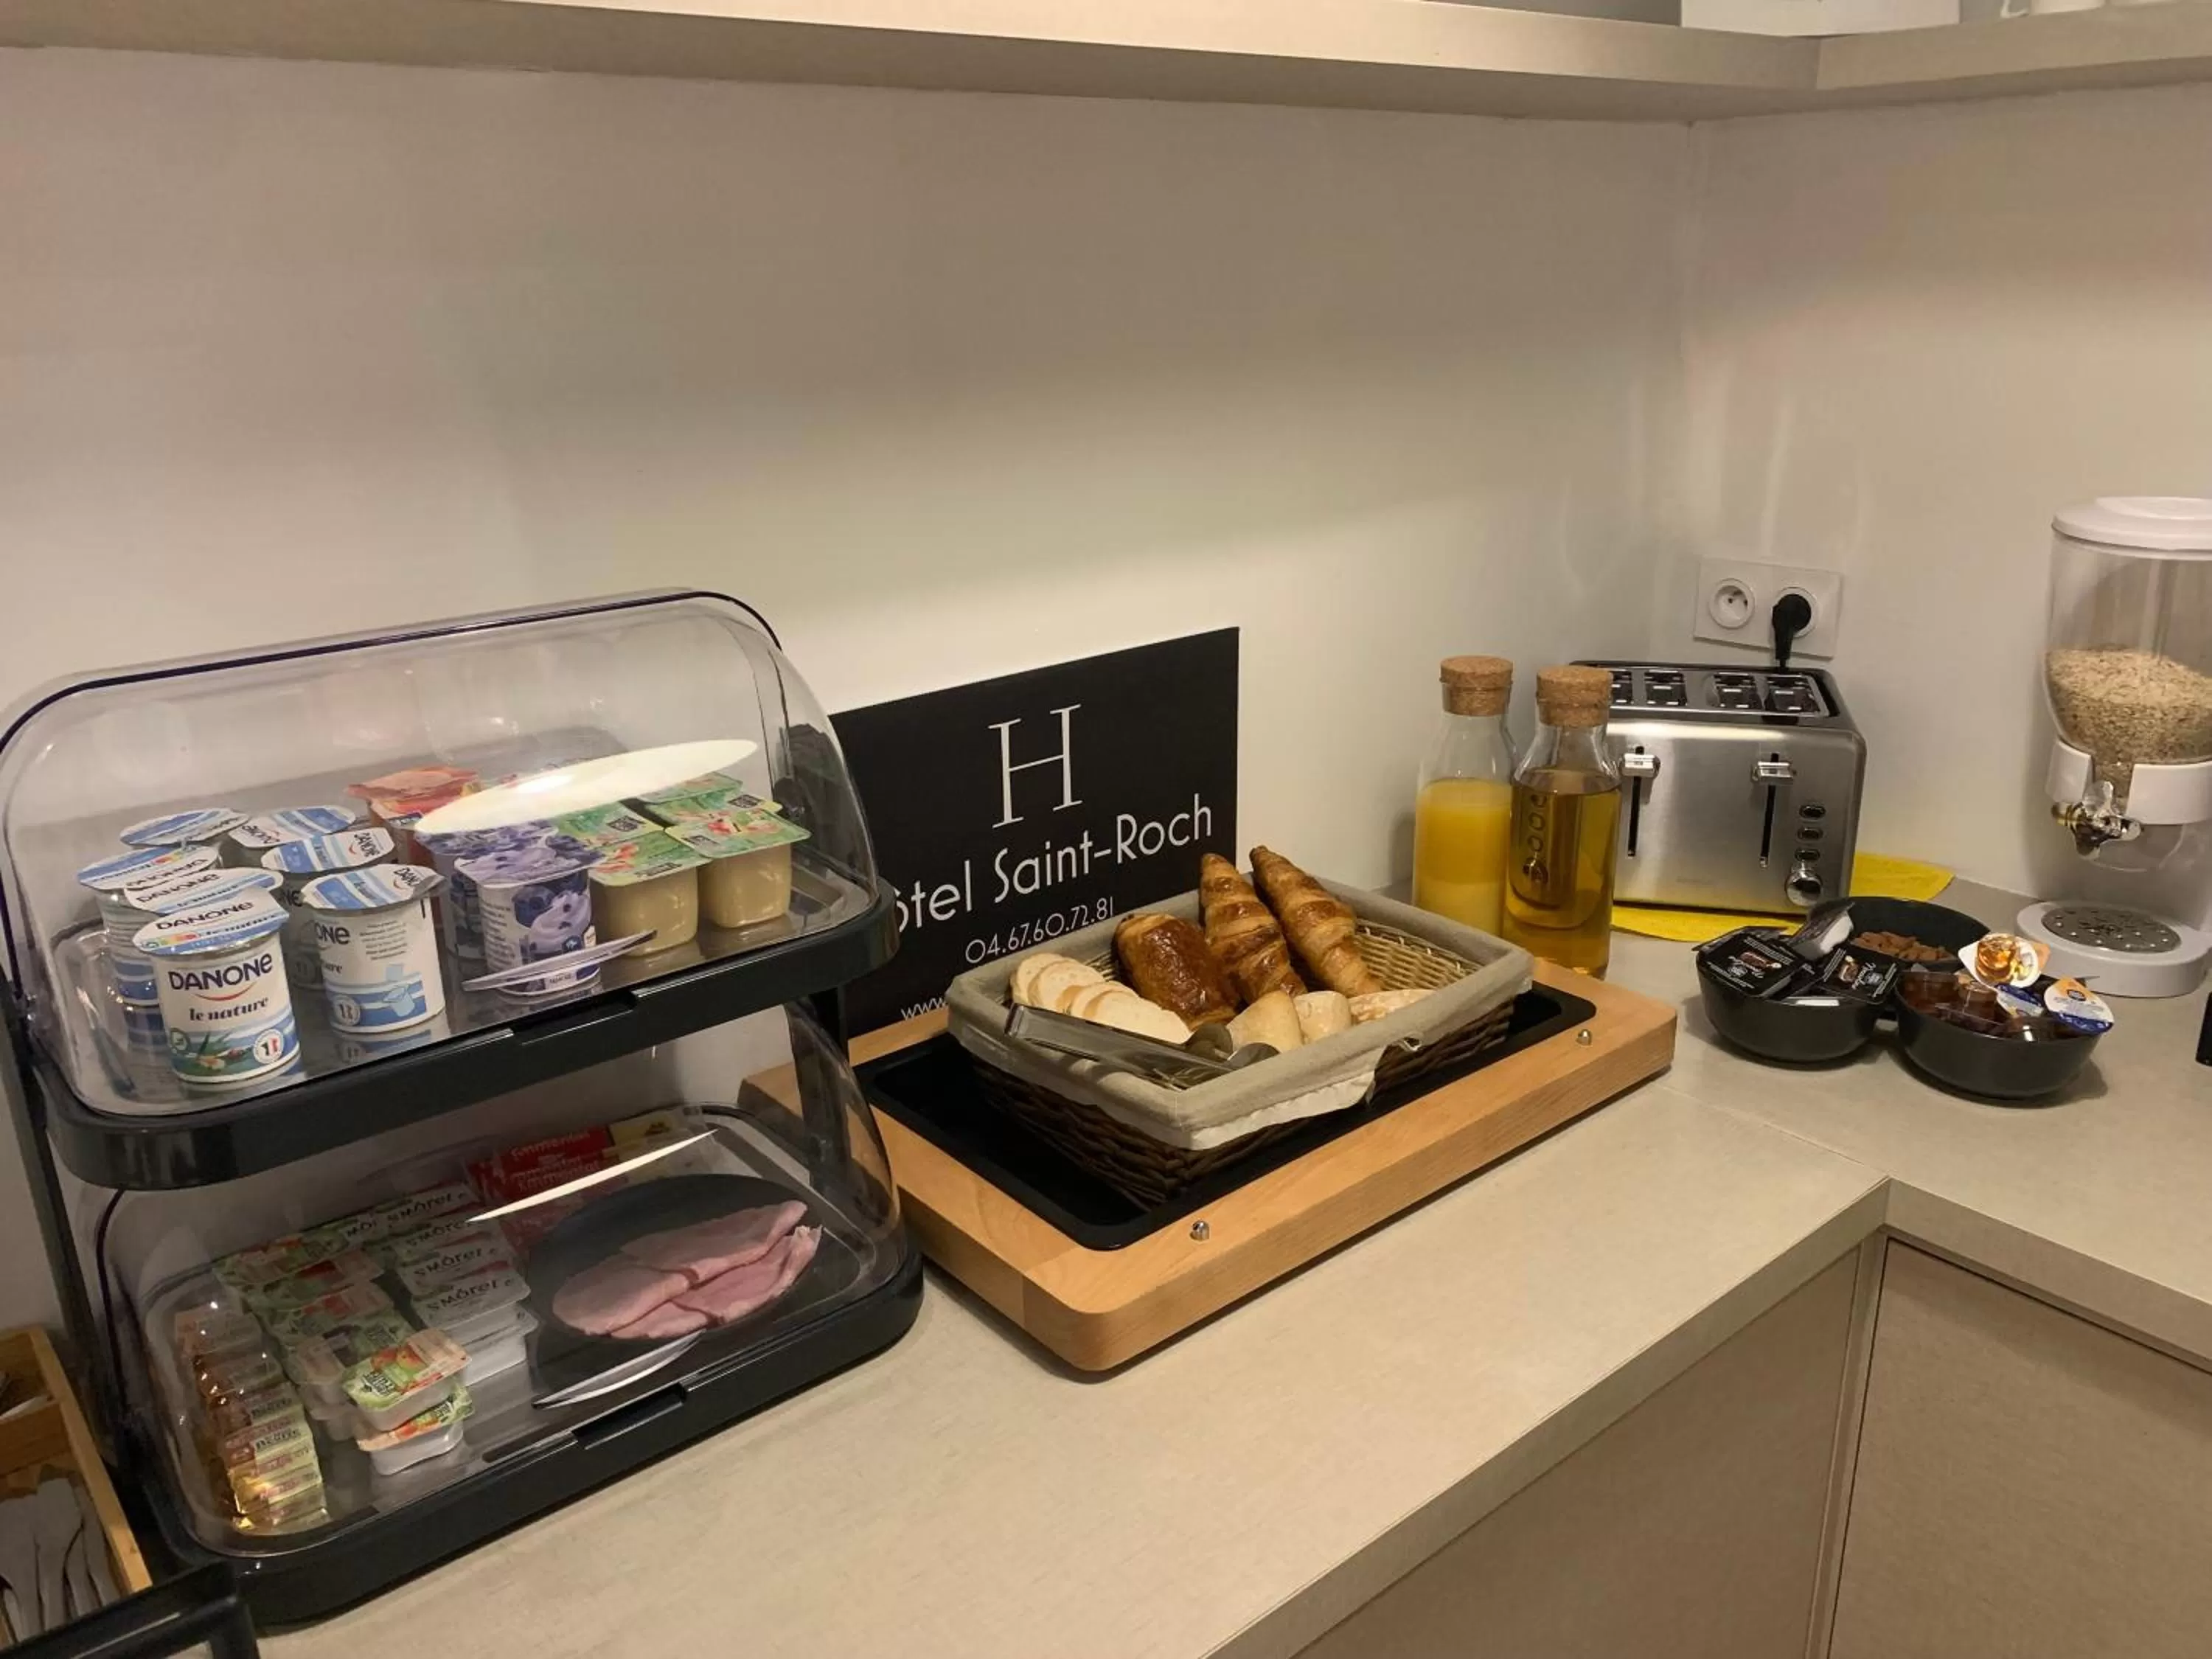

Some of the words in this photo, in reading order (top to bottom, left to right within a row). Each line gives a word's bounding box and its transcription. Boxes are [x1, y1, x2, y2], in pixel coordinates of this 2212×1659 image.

[988, 703, 1082, 829] H
[893, 859, 973, 933] tel
[994, 793, 1212, 903] Saint-Roch
